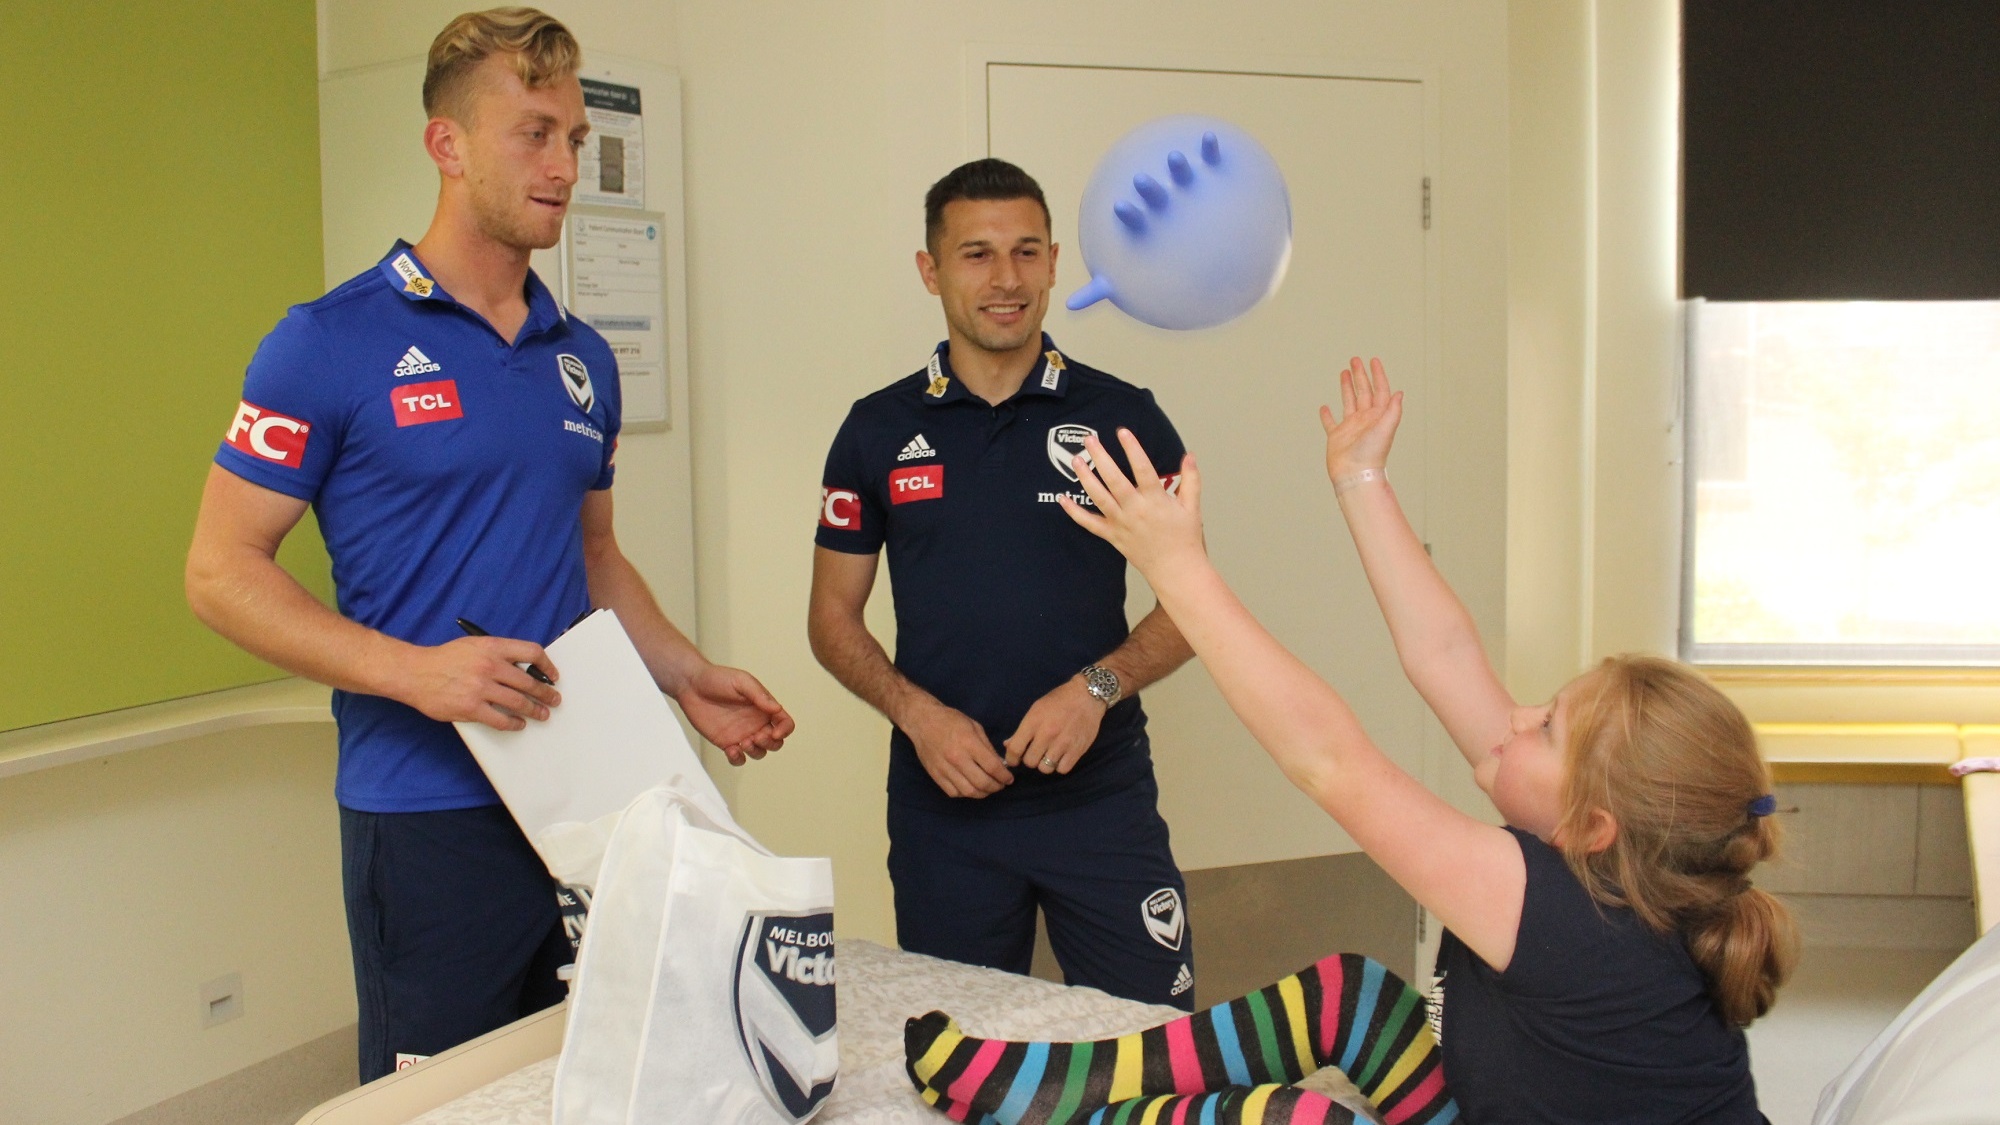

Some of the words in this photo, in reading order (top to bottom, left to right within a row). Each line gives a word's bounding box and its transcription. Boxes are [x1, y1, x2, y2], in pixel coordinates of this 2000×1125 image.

[393, 363, 441, 377] adidas
[402, 393, 452, 413] TCL
[225, 401, 301, 461] FC
[897, 449, 936, 461] adidas
[895, 476, 935, 493] TCL
[1037, 490, 1095, 506] metric
